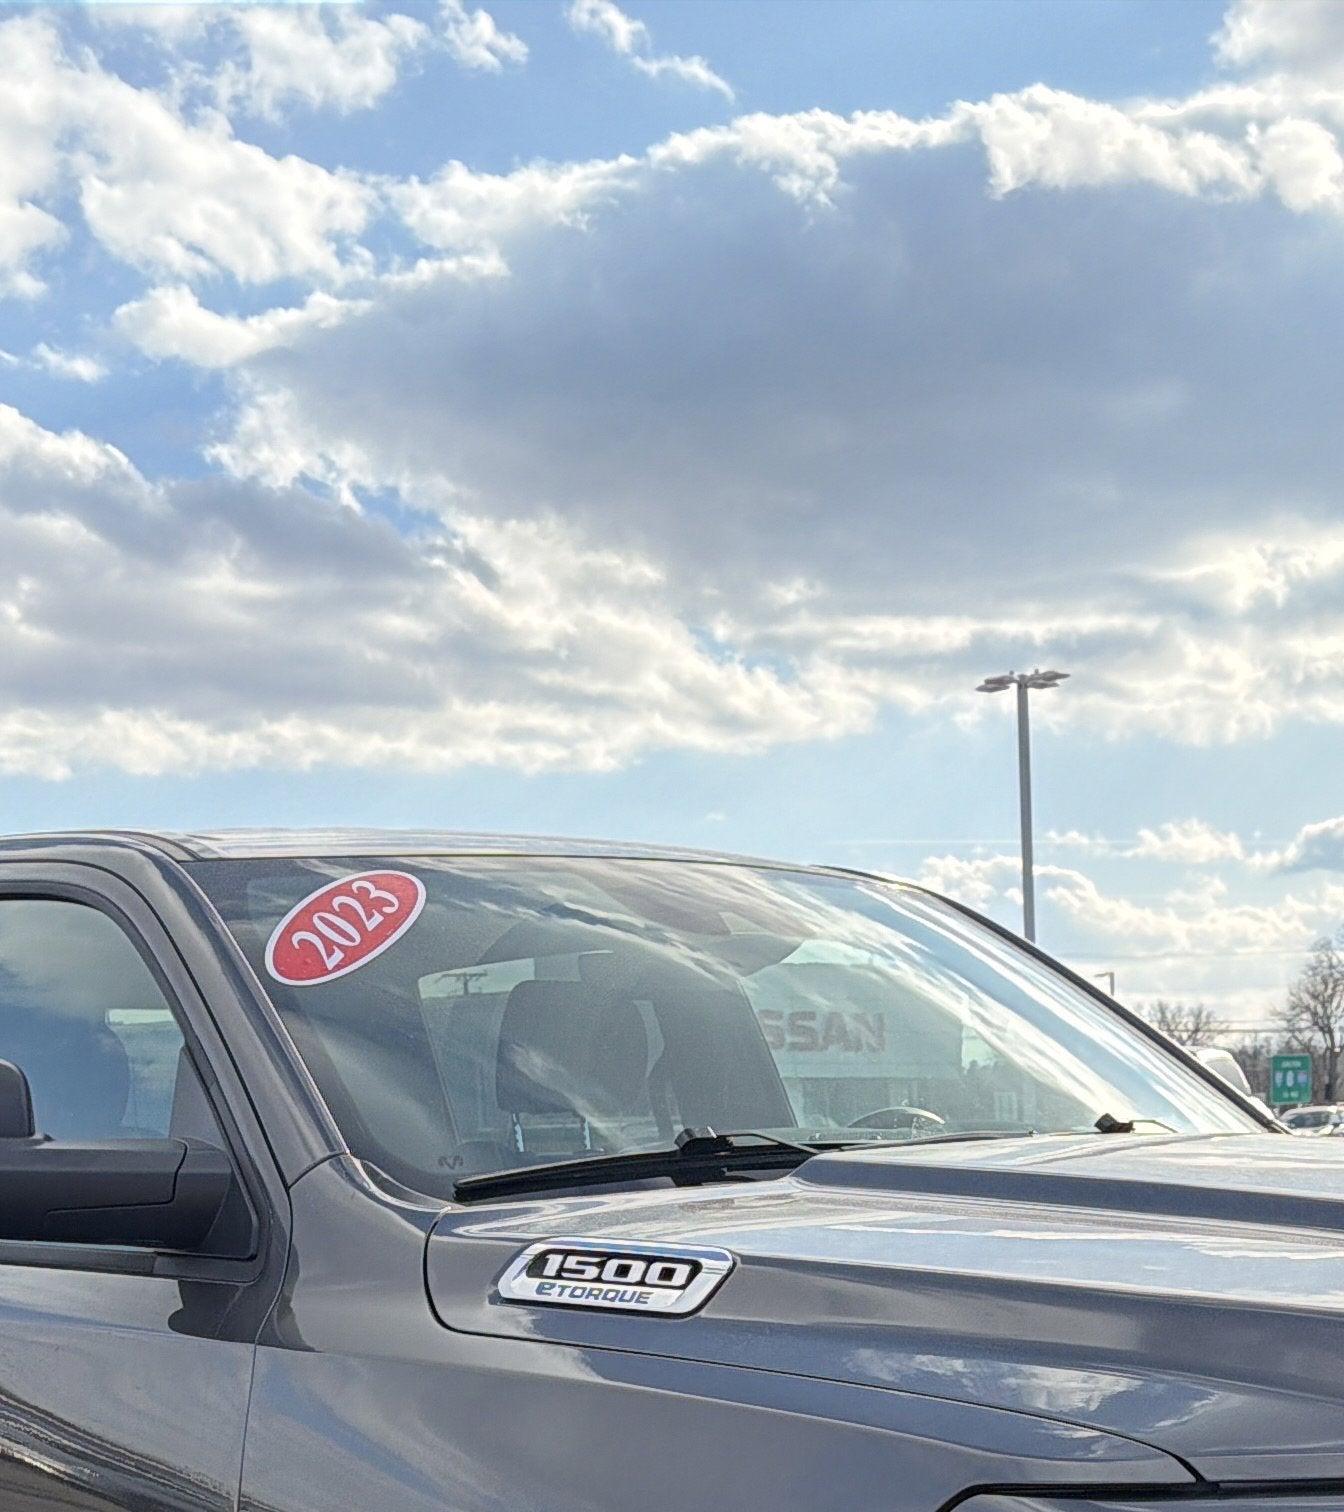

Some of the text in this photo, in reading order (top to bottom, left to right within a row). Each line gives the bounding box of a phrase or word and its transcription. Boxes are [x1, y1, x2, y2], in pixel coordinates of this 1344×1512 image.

[292, 880, 399, 971] 2023
[757, 1009, 887, 1052] SSAN
[543, 1253, 692, 1286] 1500
